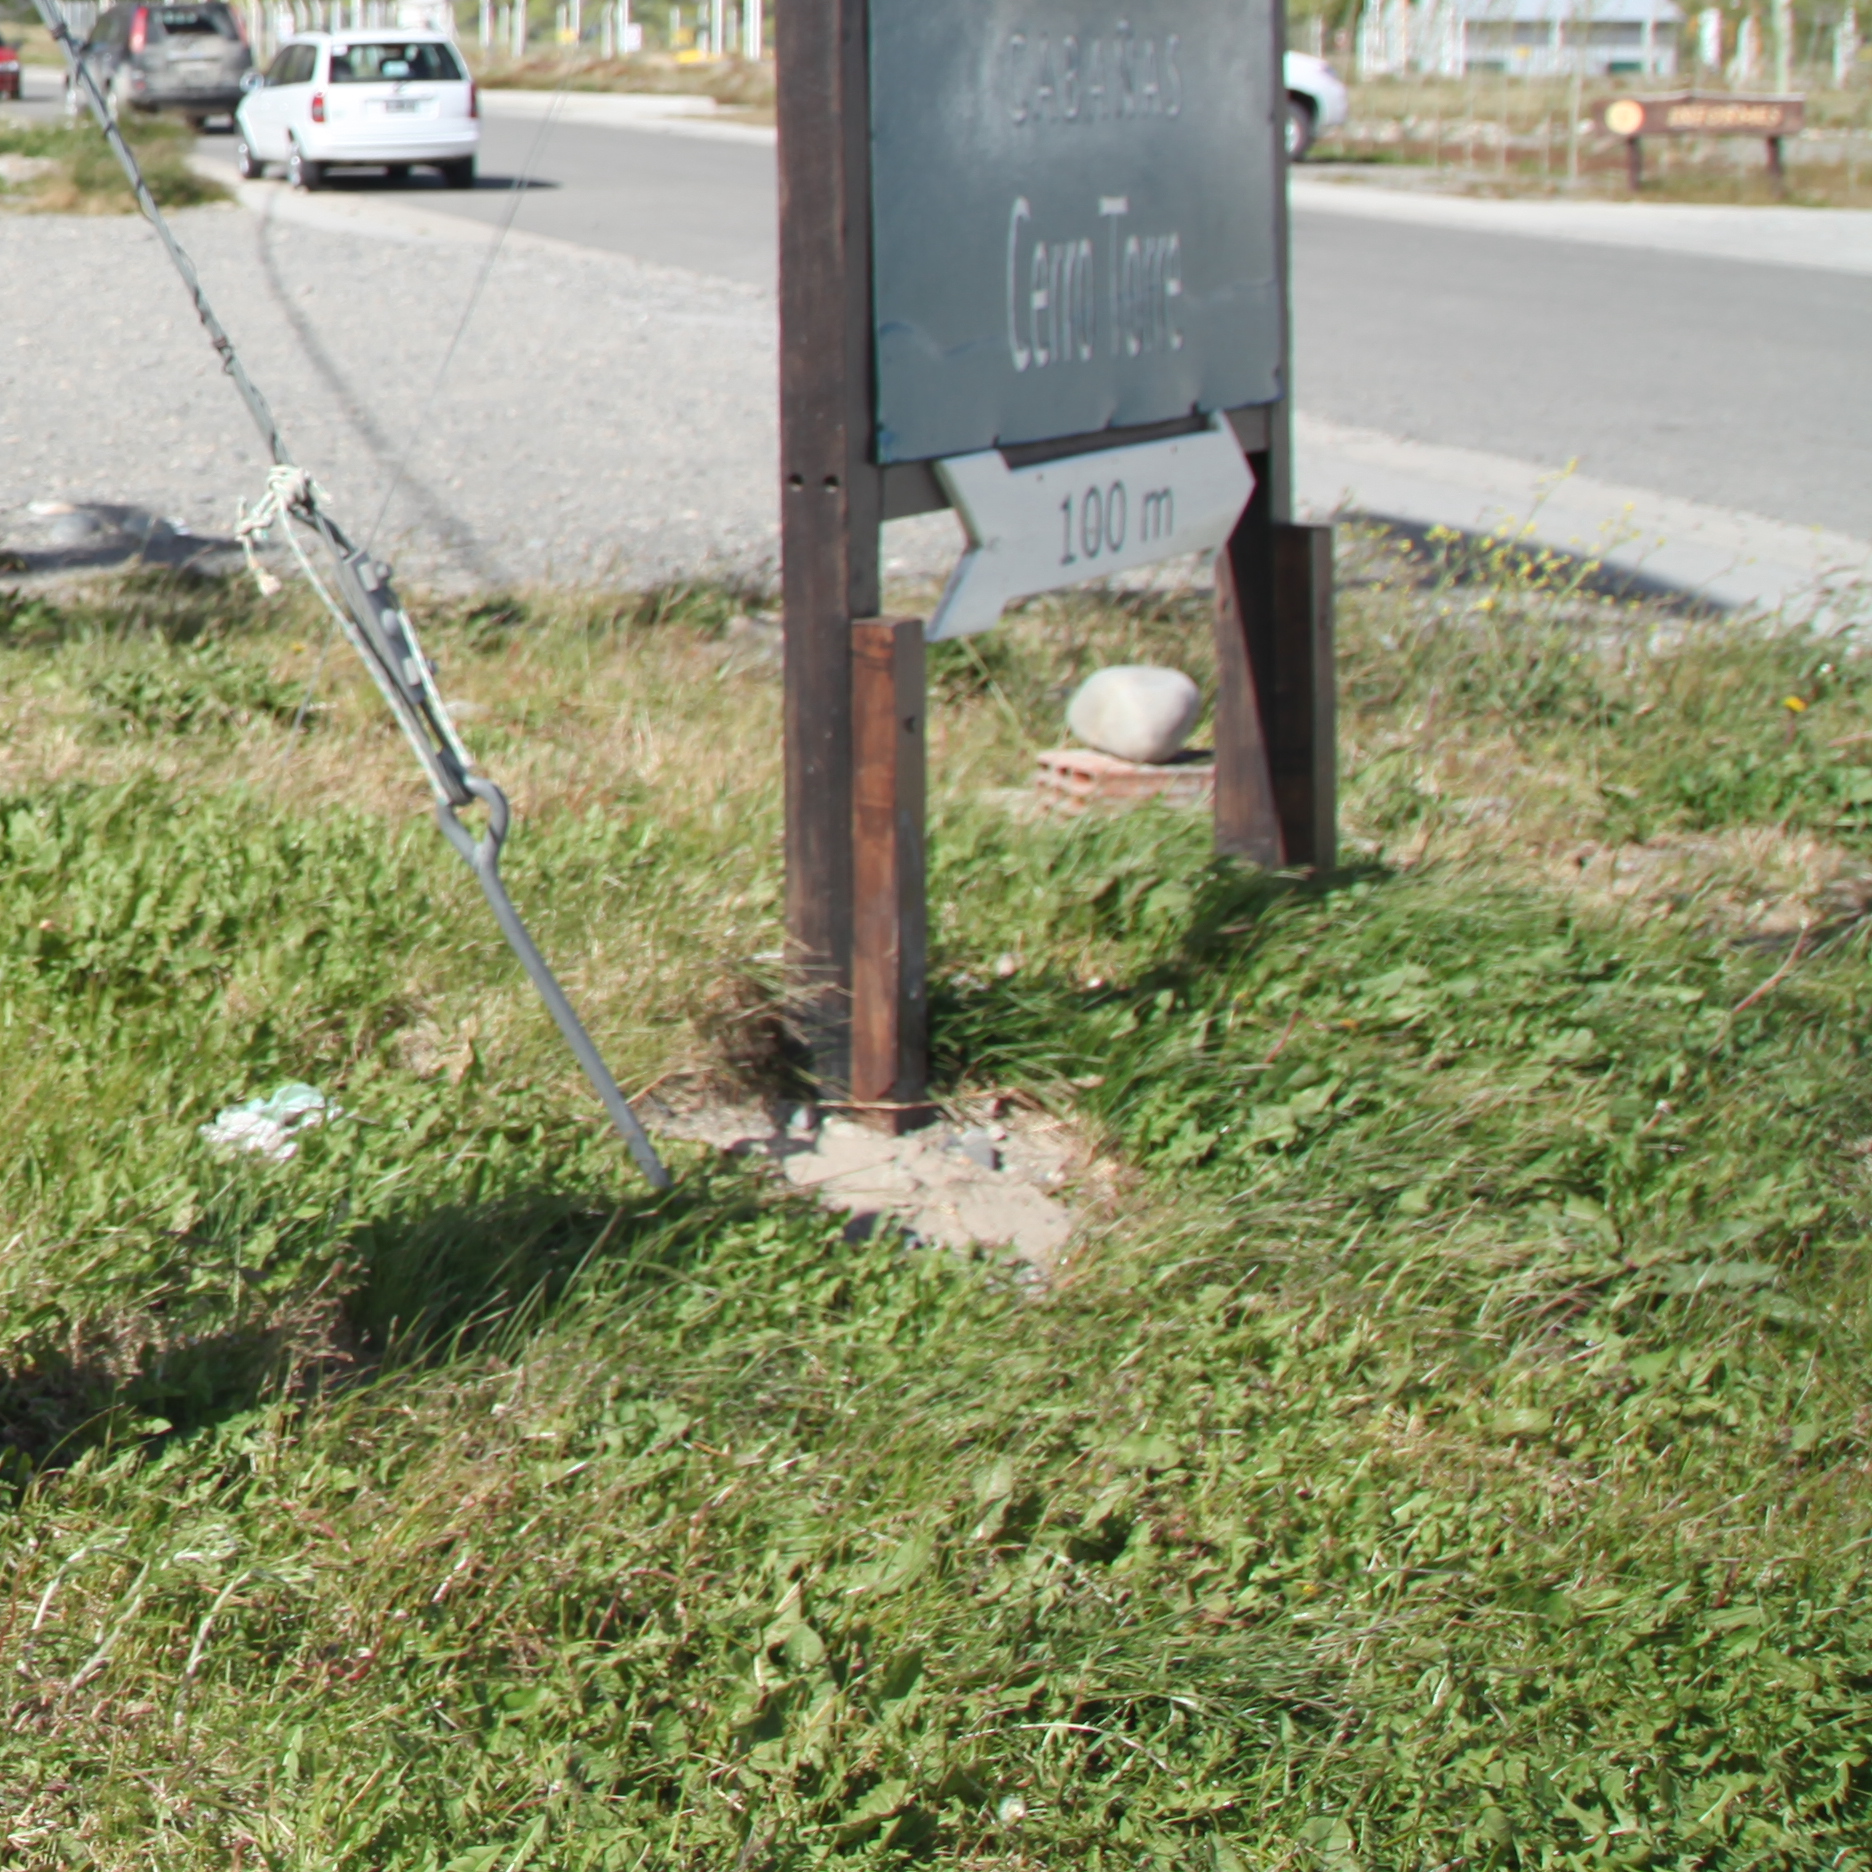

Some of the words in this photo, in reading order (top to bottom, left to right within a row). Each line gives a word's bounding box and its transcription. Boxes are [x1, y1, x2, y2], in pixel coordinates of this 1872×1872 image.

[1010, 17, 1184, 124] CABAÑAS
[1007, 194, 1095, 373] Cerro
[1097, 194, 1184, 358] Torre
[1060, 479, 1128, 565] 100
[1140, 486, 1174, 543] m
